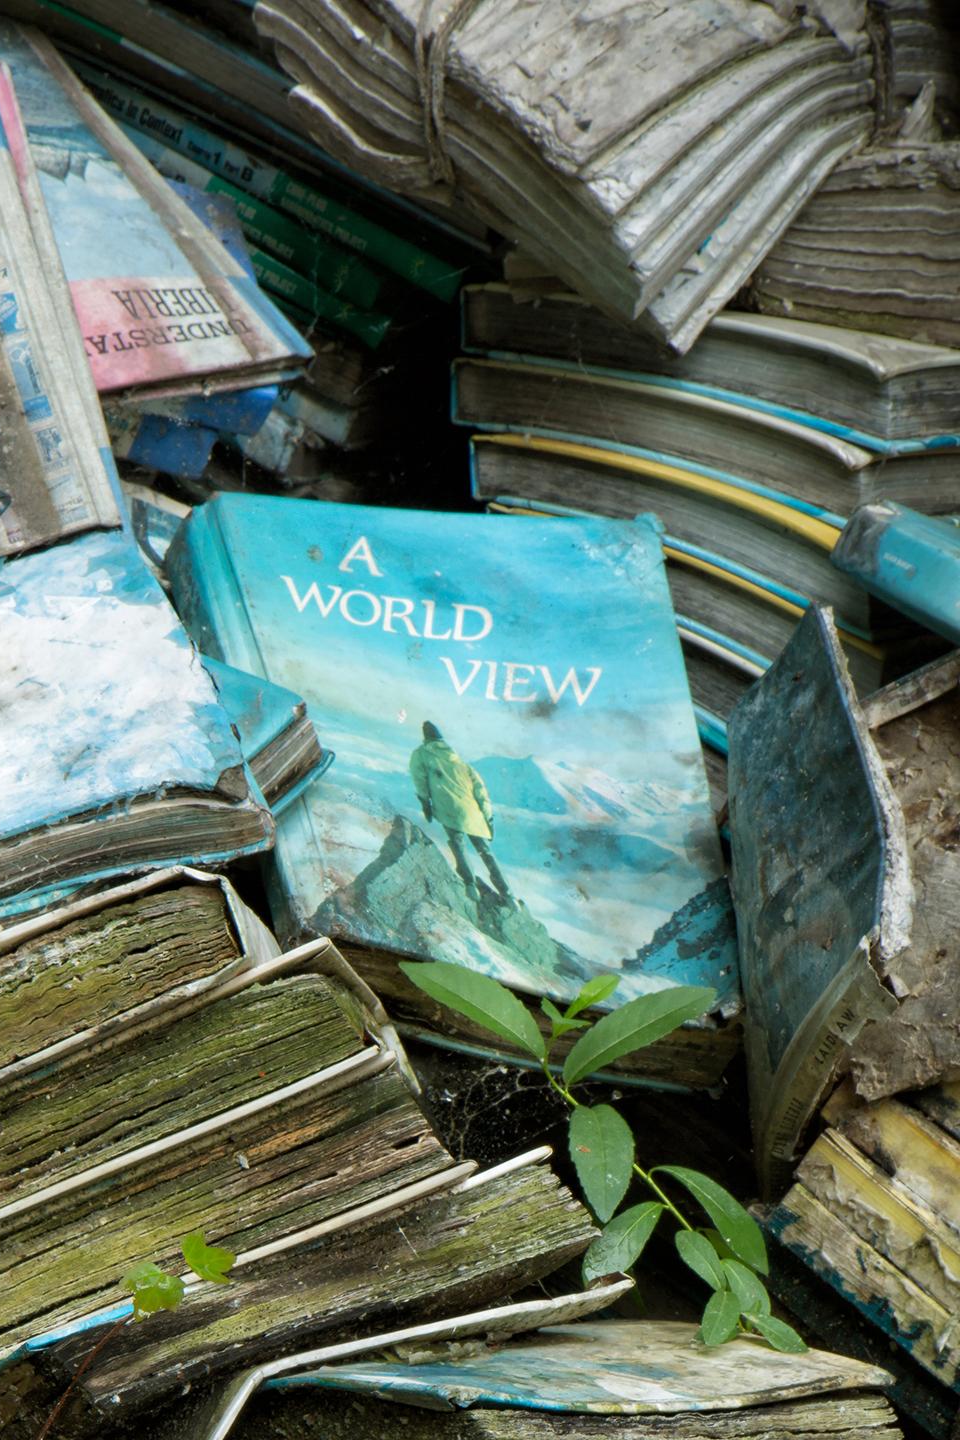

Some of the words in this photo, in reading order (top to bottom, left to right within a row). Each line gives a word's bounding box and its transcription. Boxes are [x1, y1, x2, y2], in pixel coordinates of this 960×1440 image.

[139, 102, 184, 144] Context
[241, 164, 254, 183] B
[337, 535, 385, 578] A
[280, 575, 494, 643] WORLD
[439, 656, 603, 708] VIEW
